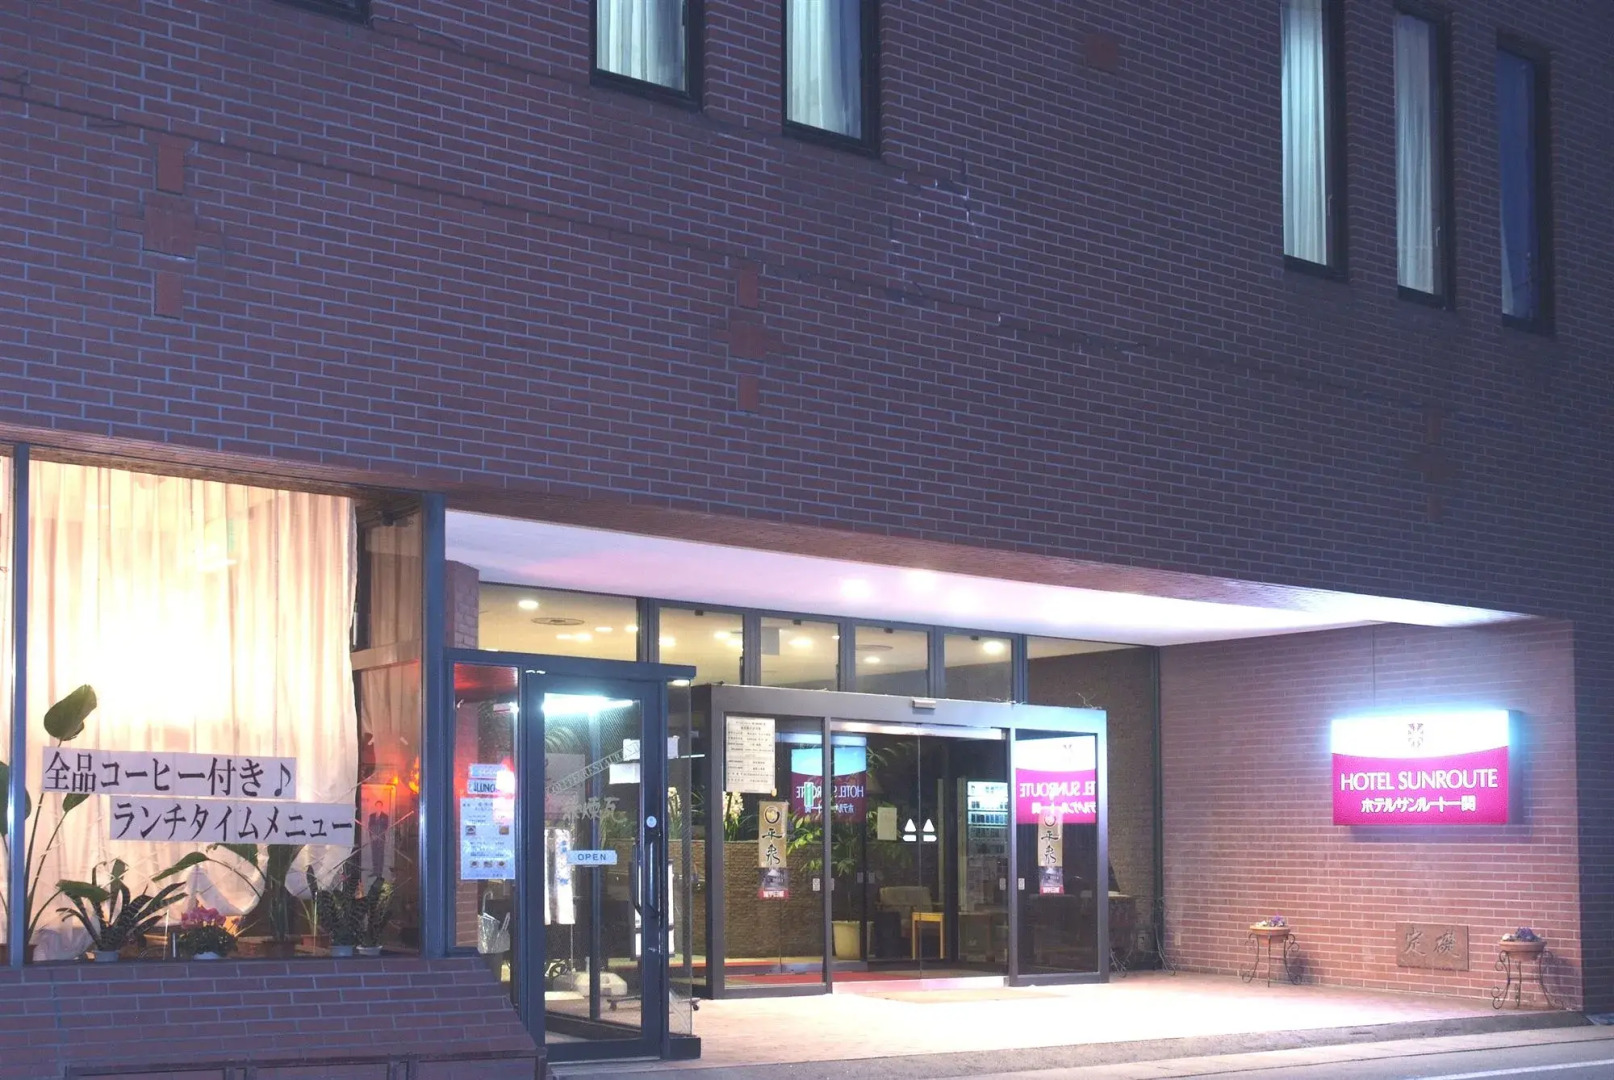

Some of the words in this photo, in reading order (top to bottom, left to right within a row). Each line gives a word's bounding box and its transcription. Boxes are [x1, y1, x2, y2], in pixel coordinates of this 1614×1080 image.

[1340, 772, 1395, 791] HOTEL
[1398, 768, 1499, 790] SUNROUTE
[113, 803, 353, 841] ランチタイムメニュー
[577, 853, 607, 861] OPEN
